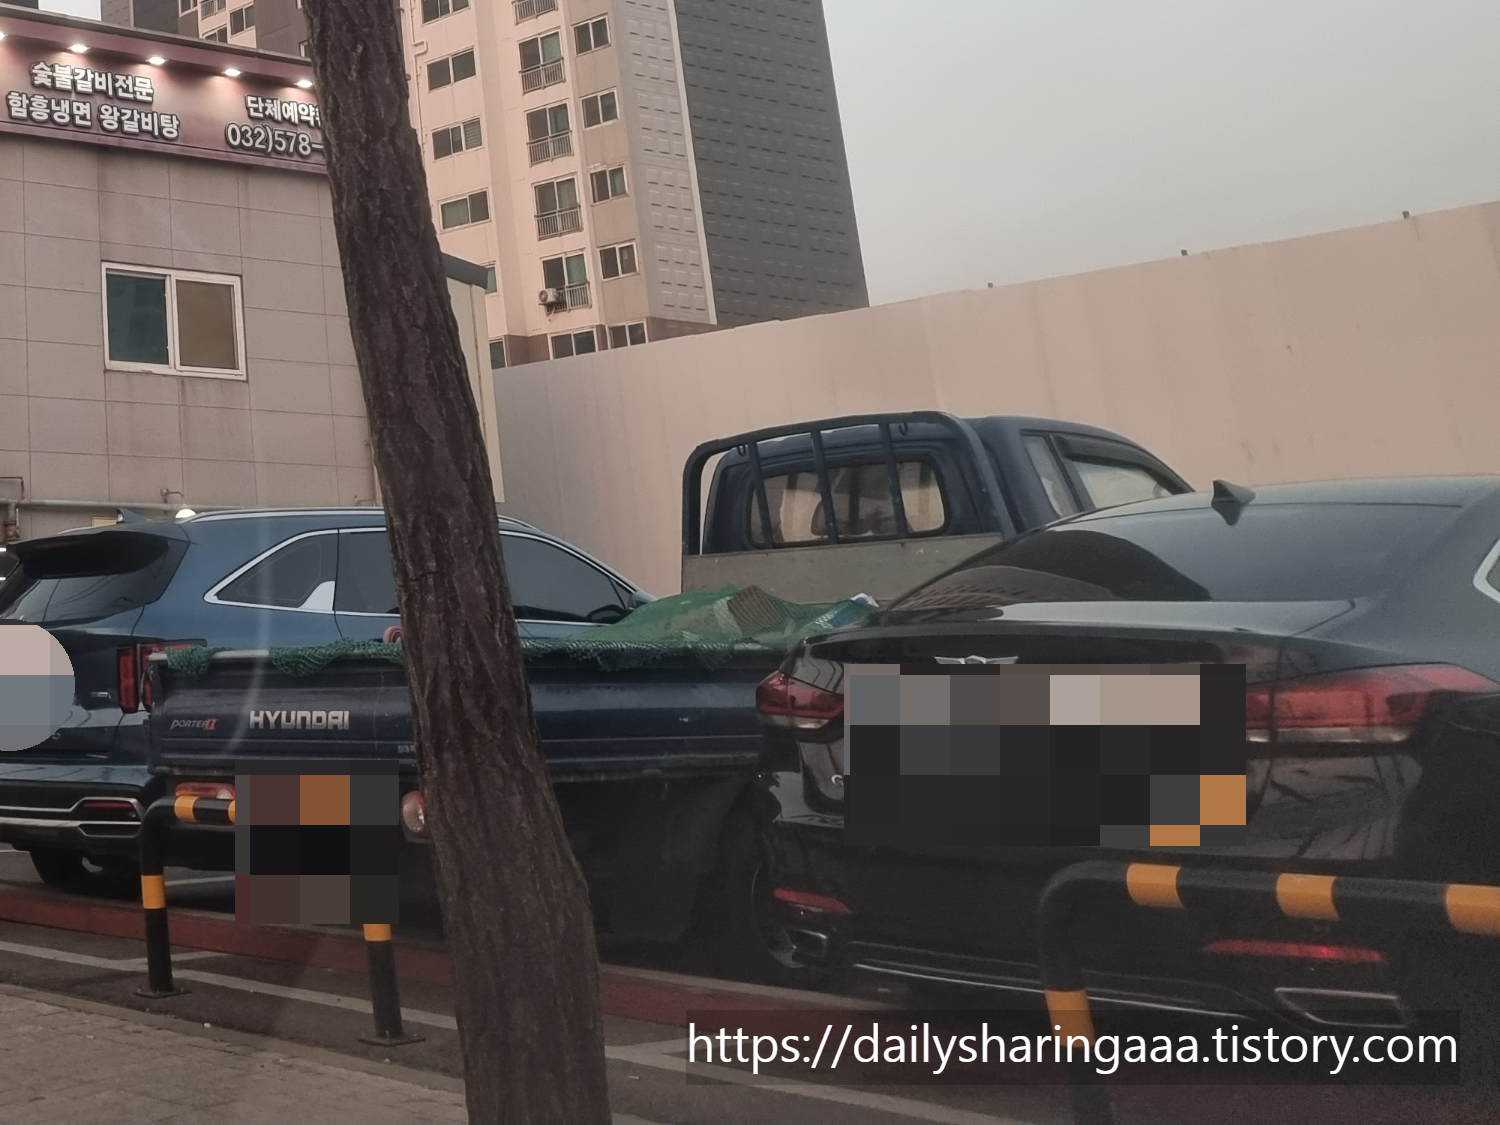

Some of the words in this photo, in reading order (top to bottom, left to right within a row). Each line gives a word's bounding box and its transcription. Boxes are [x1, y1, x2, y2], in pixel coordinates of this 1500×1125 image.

[31, 61, 154, 103] 숯불갈비전문
[7, 91, 92, 127] 함흥냉면
[99, 104, 180, 139] 왕갈비탕
[227, 124, 324, 156] 032)578-
[250, 710, 350, 730] HYUNDAI
